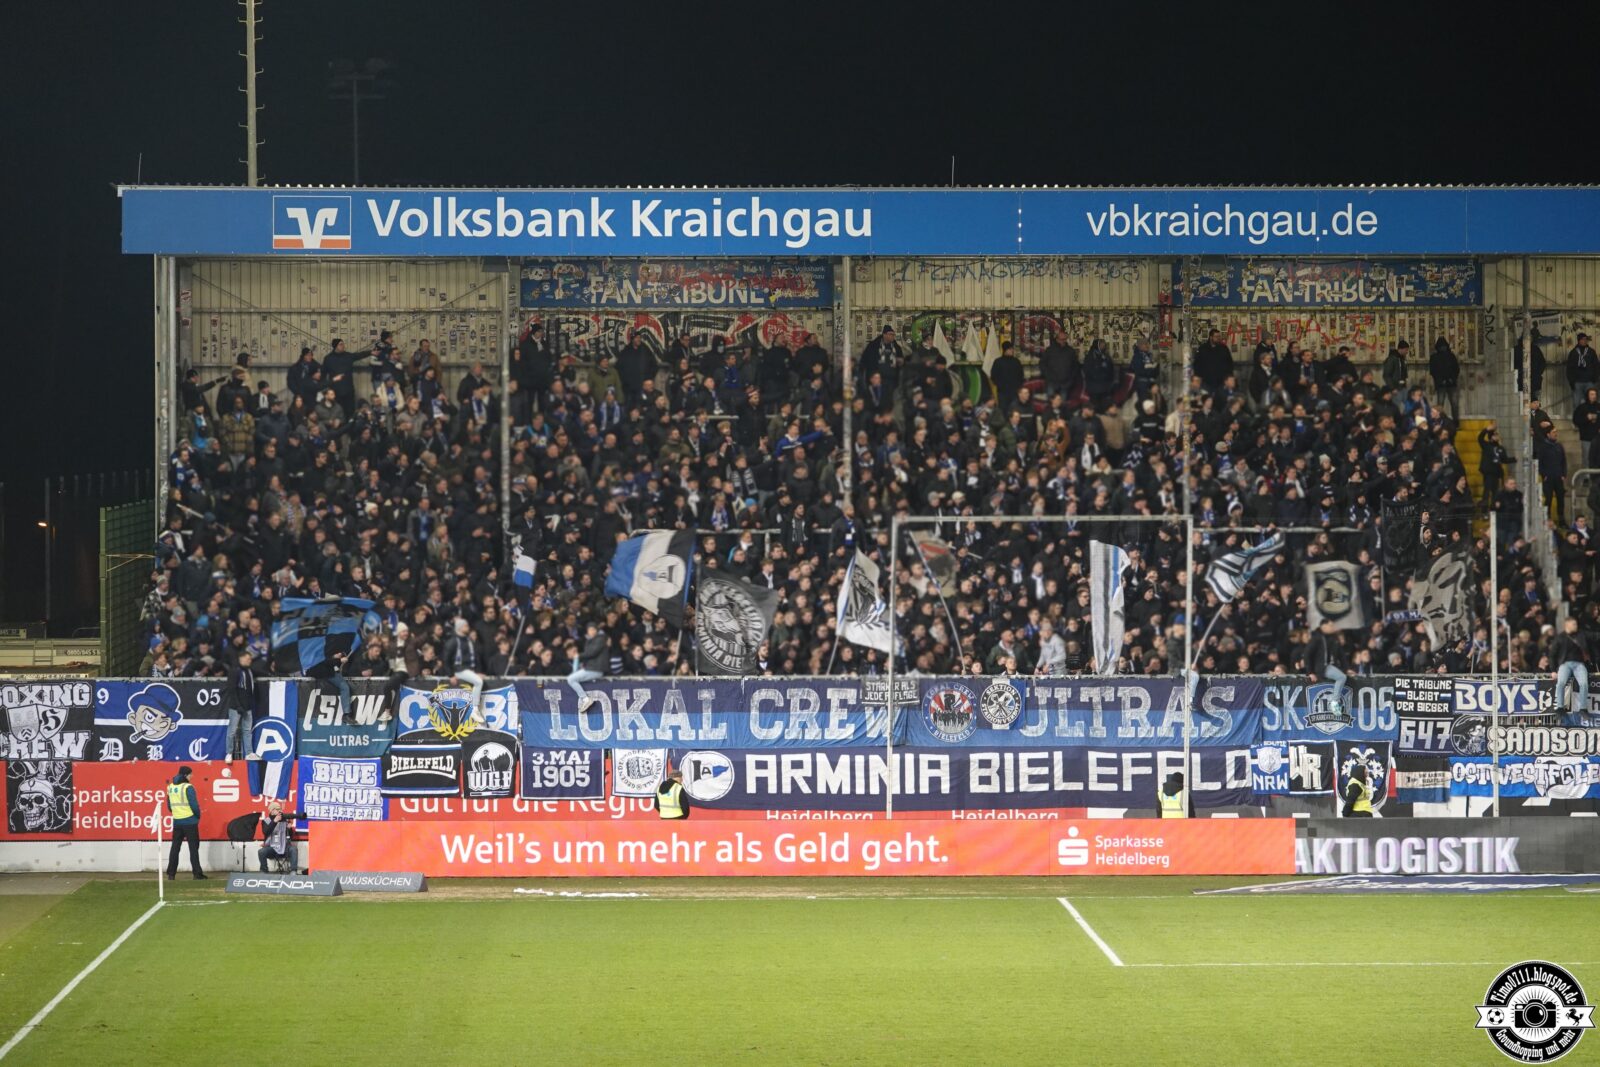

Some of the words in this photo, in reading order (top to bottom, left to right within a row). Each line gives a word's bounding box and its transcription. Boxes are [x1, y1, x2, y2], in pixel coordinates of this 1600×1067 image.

[366, 196, 616, 238] Volksbank
[631, 197, 872, 248] Kraichgau
[1086, 203, 1378, 245] vbkraichgau.de
[985, 683, 1017, 696] SEKTION
[1396, 678, 1410, 689] DIE
[0, 683, 91, 708] OXING
[884, 690, 918, 700] AFLAGE
[1407, 691, 1439, 701] BLEIBT
[1454, 683, 1537, 715] BOYS
[544, 688, 727, 742] LOKAL
[749, 687, 899, 742] CREW
[1018, 686, 1235, 739] ULTRAS
[1262, 685, 1305, 732] SK
[1357, 686, 1397, 732] 05
[1397, 701, 1415, 711] DER
[329, 735, 370, 747] ULTRAS
[1399, 721, 1451, 749] 647
[391, 755, 454, 773] BIELEFELD
[532, 750, 591, 766] 3.MAI
[314, 761, 377, 785] BLUE
[532, 766, 591, 789] 1905
[745, 753, 950, 795] ARMINIA
[969, 749, 1252, 794] BIELEFELD
[1252, 773, 1289, 790] NRW
[304, 804, 383, 821] BIELEFELD
[441, 832, 540, 864] Weil's
[552, 841, 604, 864] um
[617, 833, 707, 864] mehr
[716, 833, 762, 864] als
[774, 833, 853, 864] Geld
[862, 834, 949, 871] geht.
[1095, 836, 1164, 850] Sparkasse
[1095, 852, 1170, 868] Heidelberg
[245, 878, 314, 890] ORENDA
